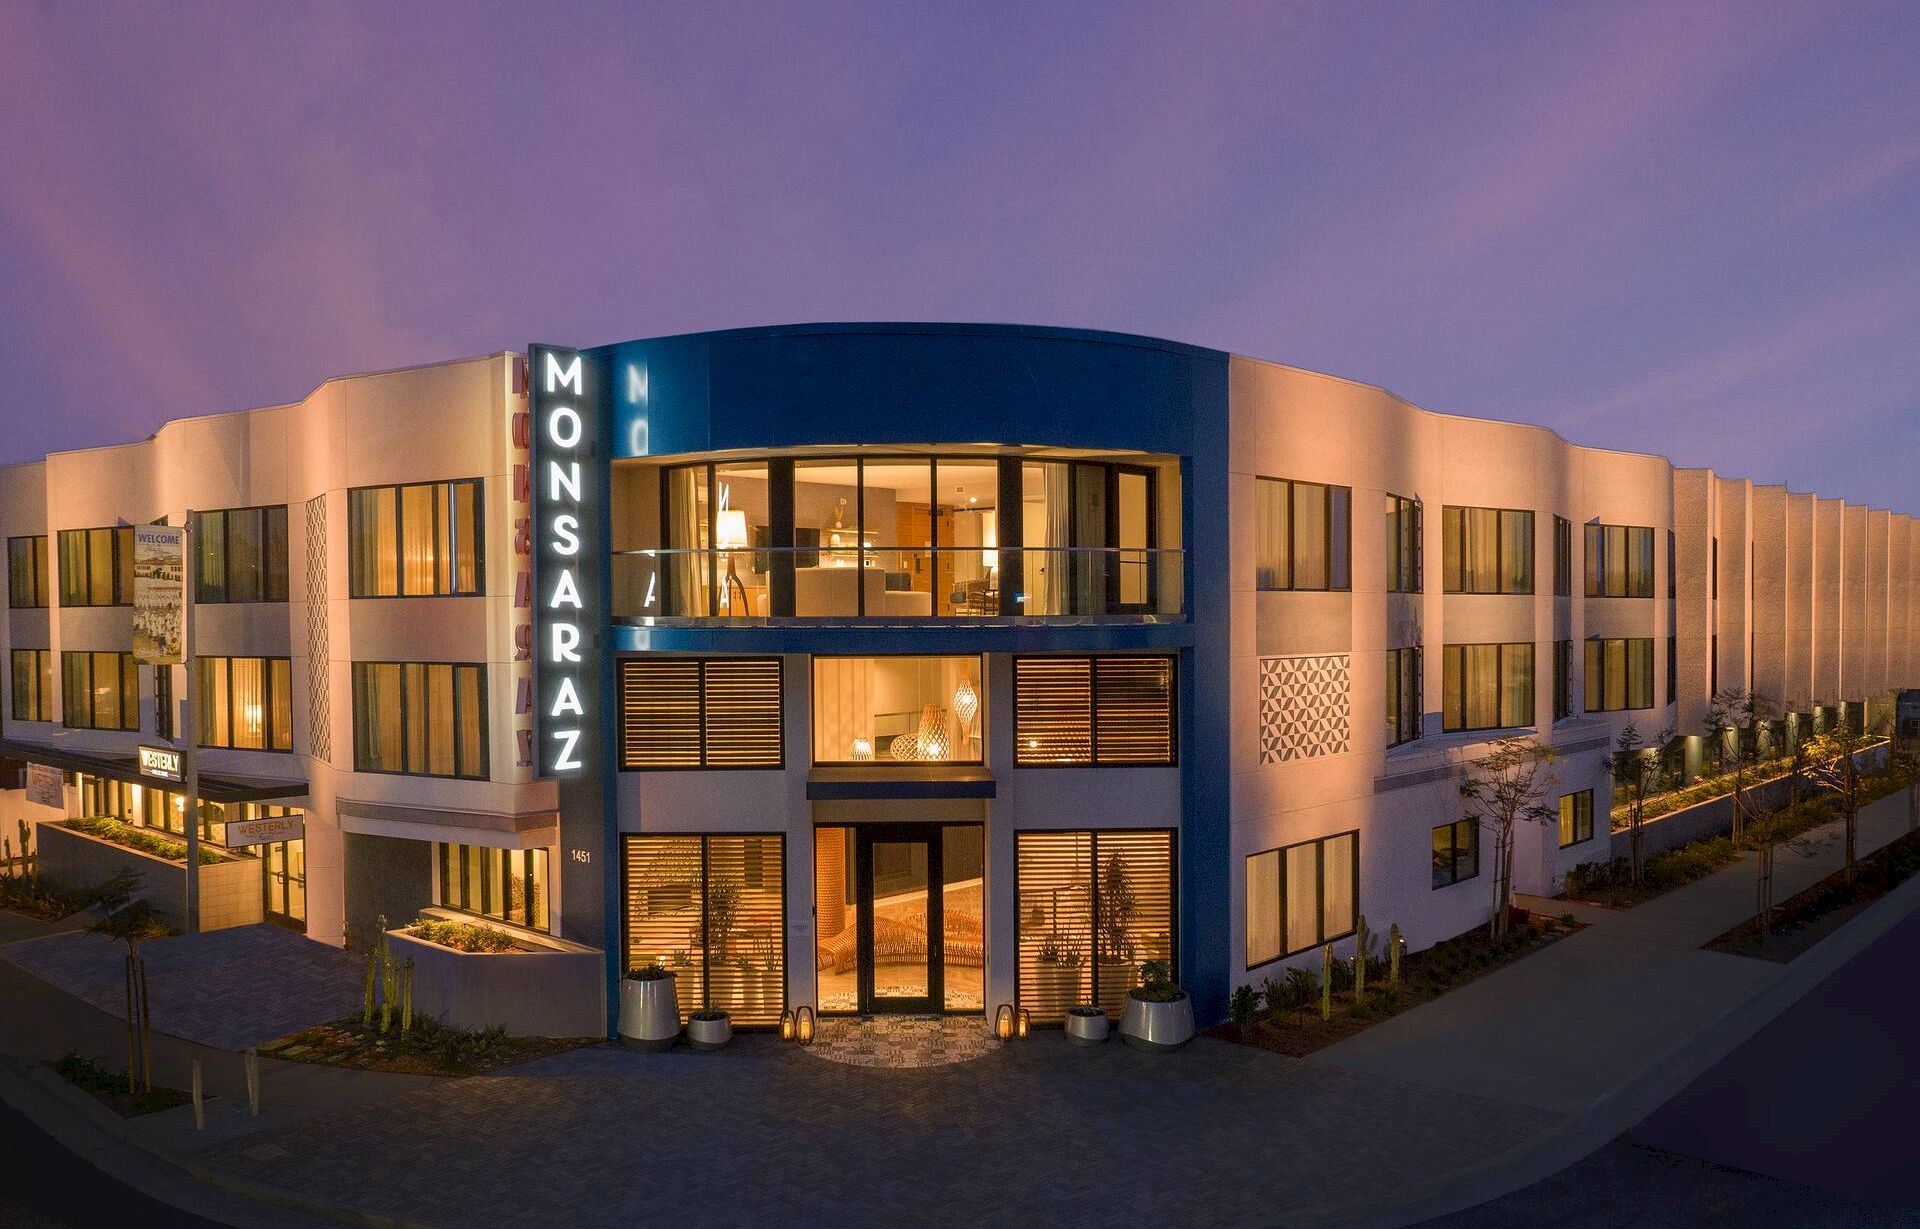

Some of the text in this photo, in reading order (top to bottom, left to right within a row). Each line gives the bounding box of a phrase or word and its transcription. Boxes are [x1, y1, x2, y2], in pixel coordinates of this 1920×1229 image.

[138, 534, 180, 544] WELCOME
[546, 352, 583, 771] MONSARAZ
[141, 750, 179, 771] WESTERLY
[238, 820, 294, 834] WESTERLY
[571, 849, 590, 863] 1451
